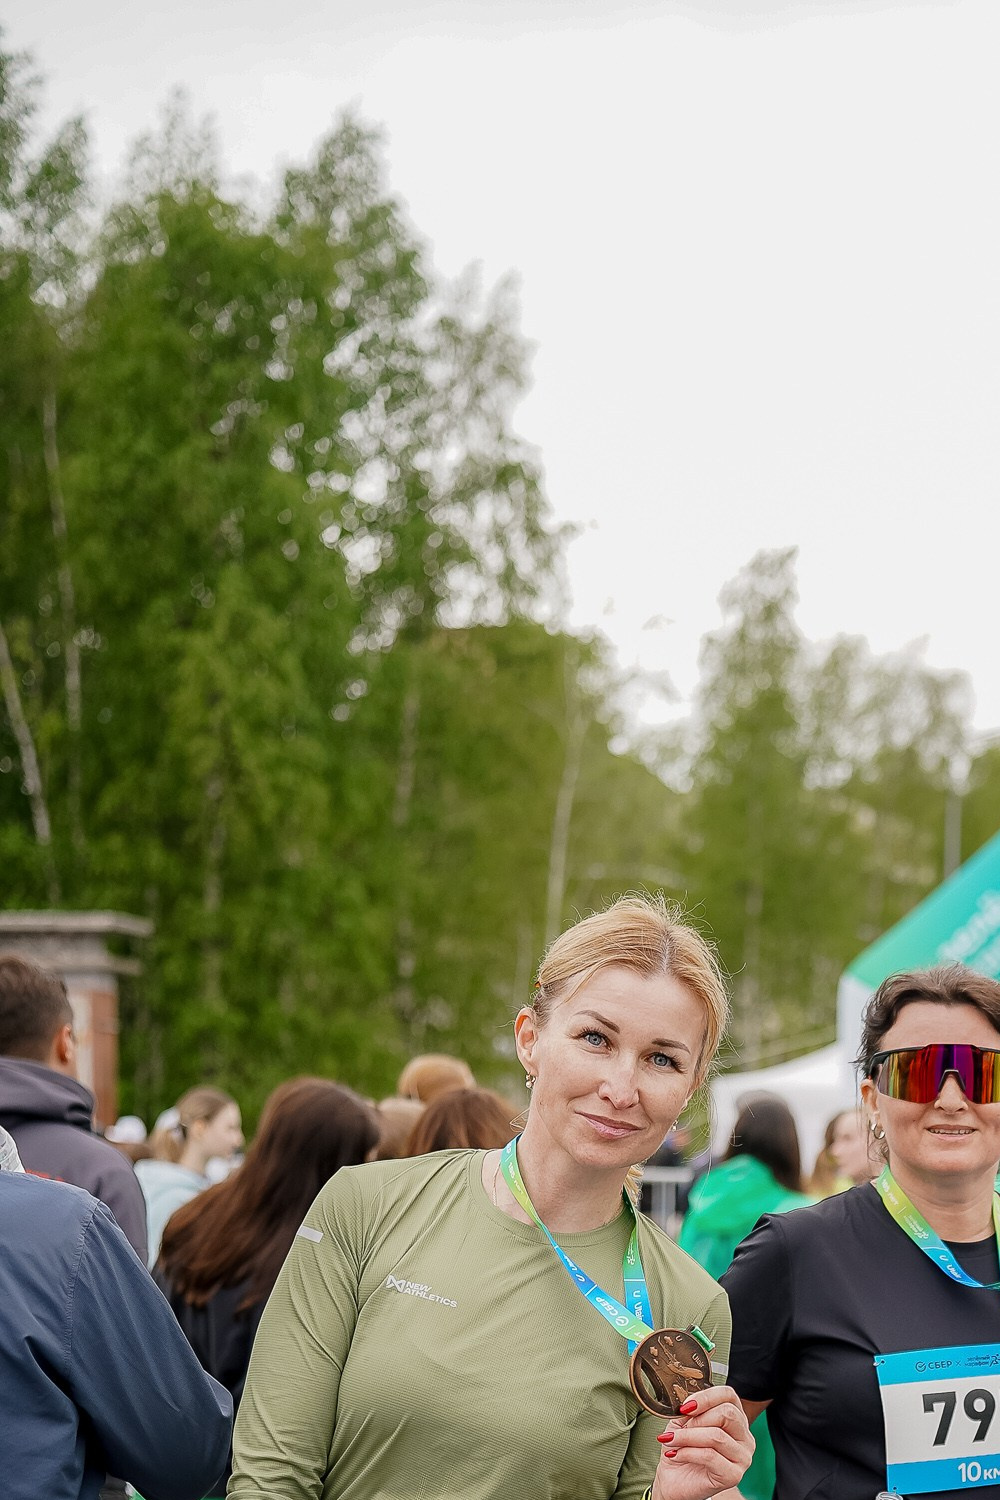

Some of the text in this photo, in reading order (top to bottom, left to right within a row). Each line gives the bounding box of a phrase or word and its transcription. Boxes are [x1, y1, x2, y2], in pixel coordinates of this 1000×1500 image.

[406, 1281, 433, 1292] NEW
[403, 1287, 458, 1308] ATHLETICS
[928, 1360, 953, 1369] СБЕР
